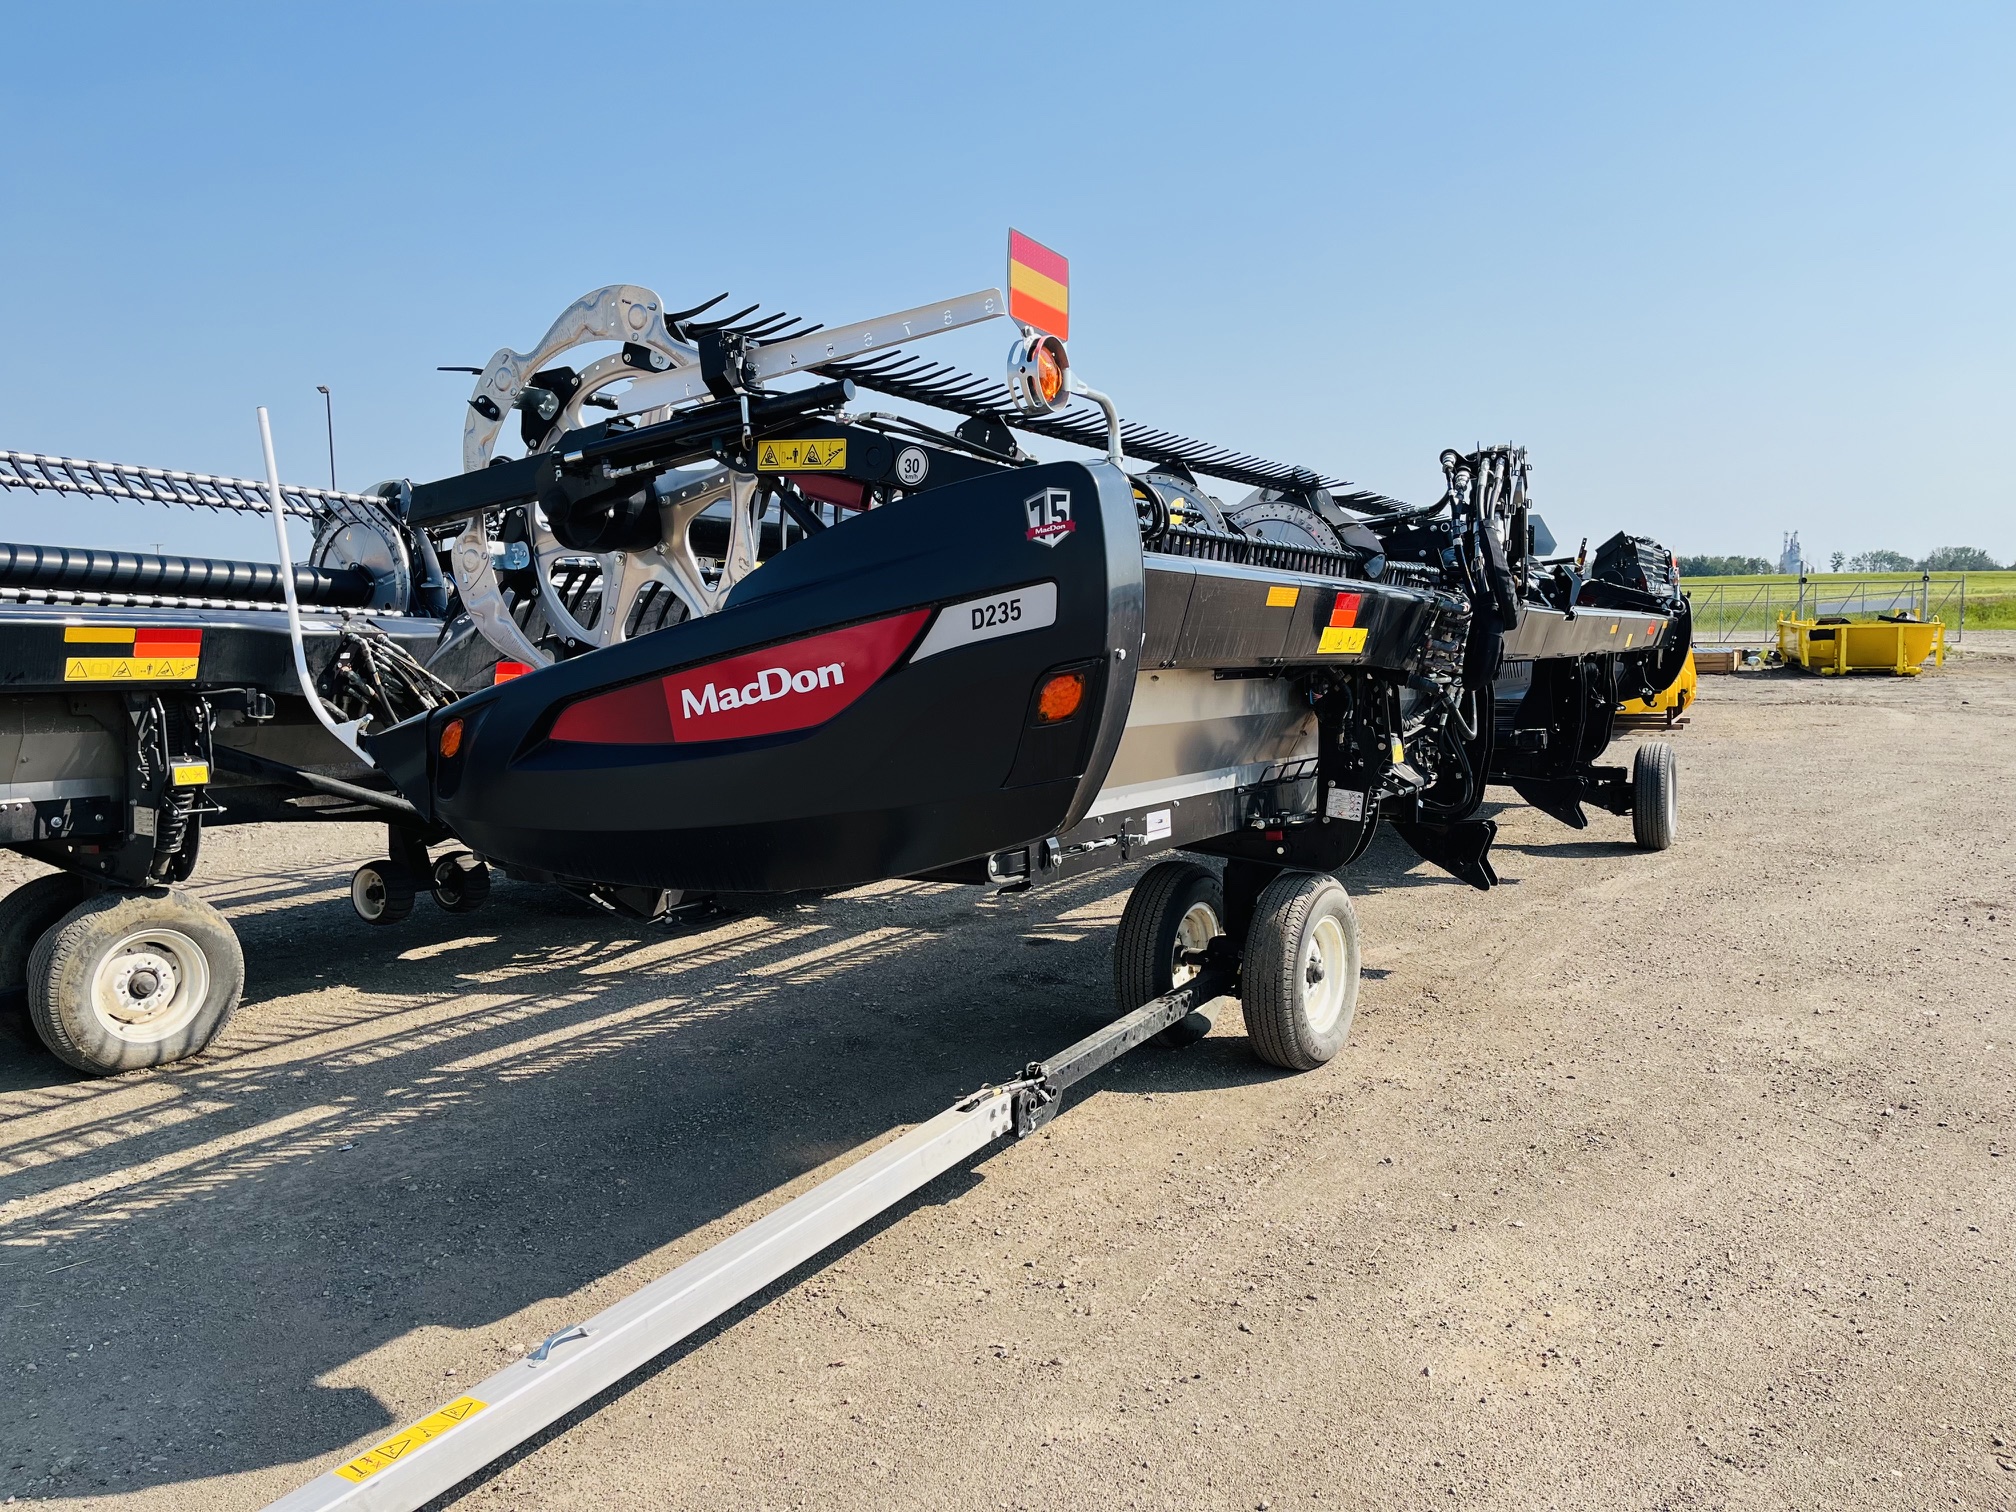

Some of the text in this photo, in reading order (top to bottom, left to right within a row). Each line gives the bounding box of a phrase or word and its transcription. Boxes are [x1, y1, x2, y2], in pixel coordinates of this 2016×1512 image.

[904, 458, 920, 473] 30
[1035, 524, 1066, 535] MacDon
[971, 598, 1022, 631] D235
[681, 662, 845, 719] MacDon
